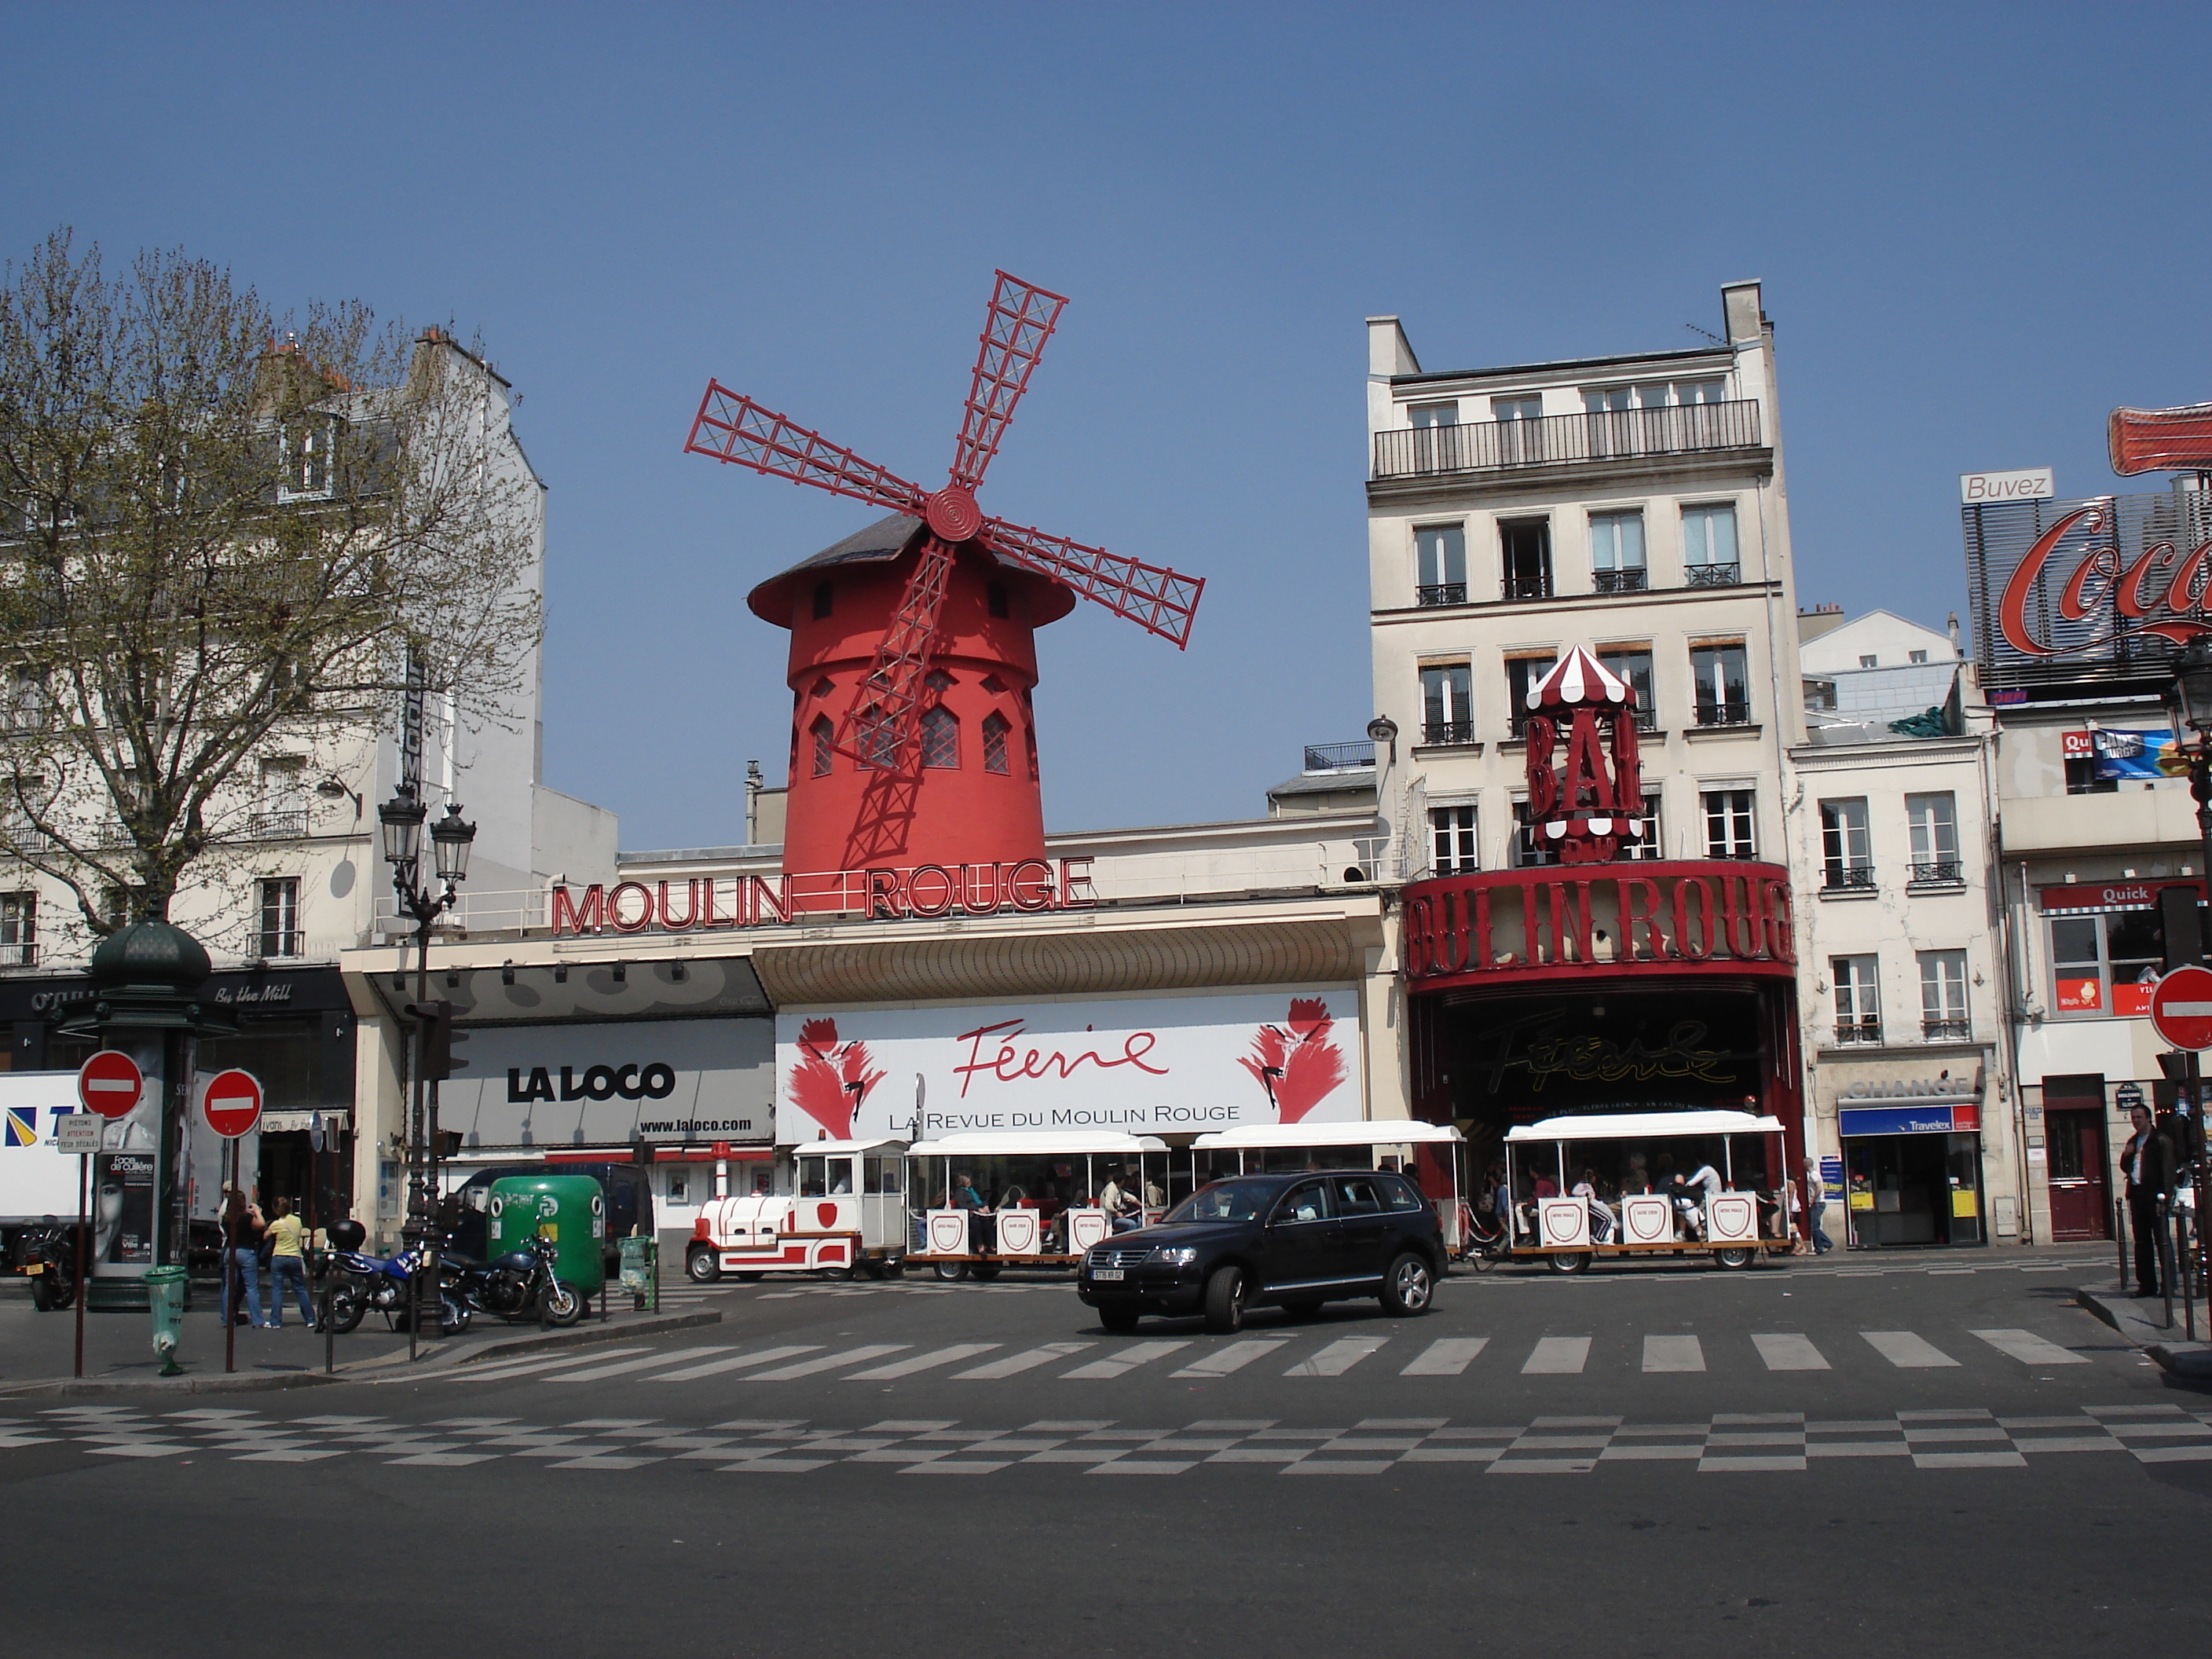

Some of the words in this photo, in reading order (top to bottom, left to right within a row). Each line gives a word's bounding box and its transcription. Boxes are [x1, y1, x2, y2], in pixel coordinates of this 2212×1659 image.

[1967, 476, 2046, 499] Buvez
[2066, 736, 2089, 750] Qu
[551, 873, 793, 935] MOULIN
[865, 856, 1094, 919] ROUGE
[2102, 886, 2148, 903] Quick
[1404, 881, 1597, 977] OULIN
[1615, 876, 1794, 962] ROUG
[236, 986, 258, 1002] the
[260, 984, 292, 1002] Mill
[507, 1067, 557, 1103] LA
[560, 1063, 676, 1102] LOCO
[1849, 1078, 1970, 1098] CHANGE
[640, 1119, 752, 1133] www.laloco.com
[927, 1112, 1004, 1129] REVUE
[1012, 1111, 1043, 1126] DU
[1051, 1108, 1146, 1126] MOULIN
[1154, 1105, 1240, 1122] ROUGE
[1909, 1120, 1950, 1130] Travelex
[115, 1155, 136, 1165] Face
